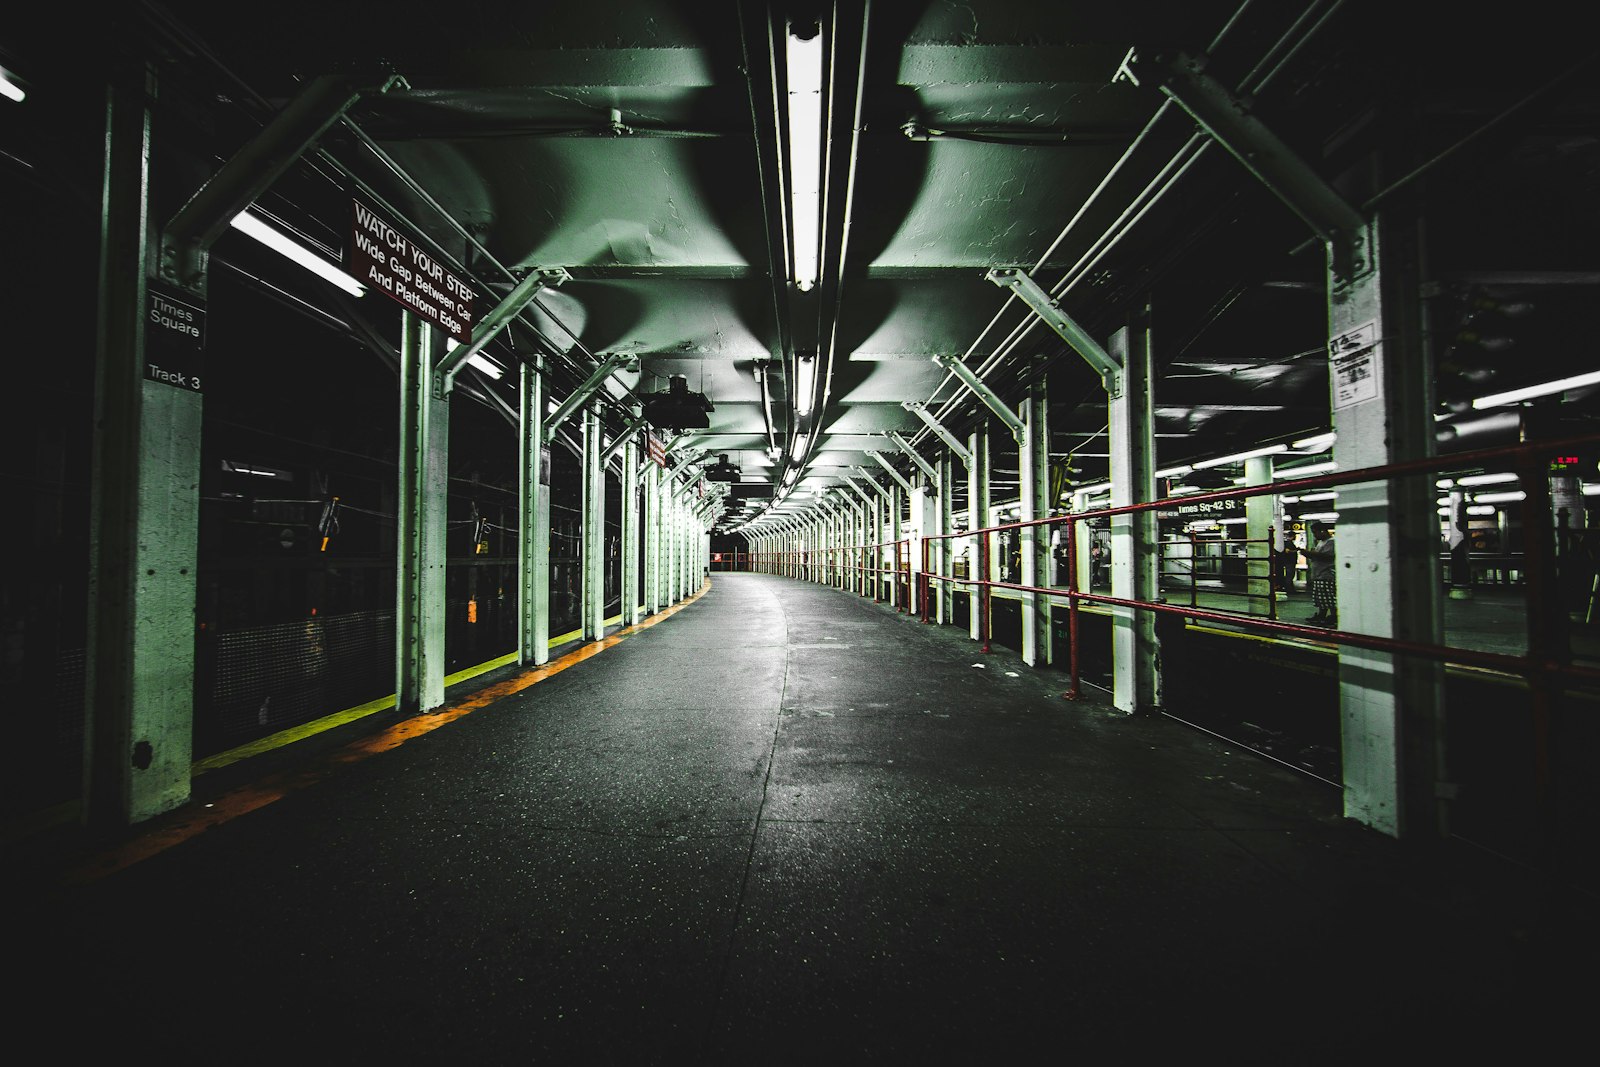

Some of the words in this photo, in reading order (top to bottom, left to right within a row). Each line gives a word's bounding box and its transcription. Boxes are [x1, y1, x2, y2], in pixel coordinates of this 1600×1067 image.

[355, 202, 407, 257] WATCH
[411, 246, 443, 283] YOUR
[446, 274, 473, 302] STEP
[355, 230, 386, 264] Wide
[389, 256, 412, 283] Gap
[415, 273, 455, 311] Between
[457, 303, 472, 322] Car
[151, 294, 193, 322] Times
[368, 264, 392, 291] And
[395, 281, 438, 319] Platform
[439, 310, 462, 334] Edge
[150, 309, 200, 338] Square
[148, 363, 186, 386] Track
[191, 376, 201, 390] 3
[1199, 501, 1224, 512] Sq-42
[1225, 500, 1236, 510] St
